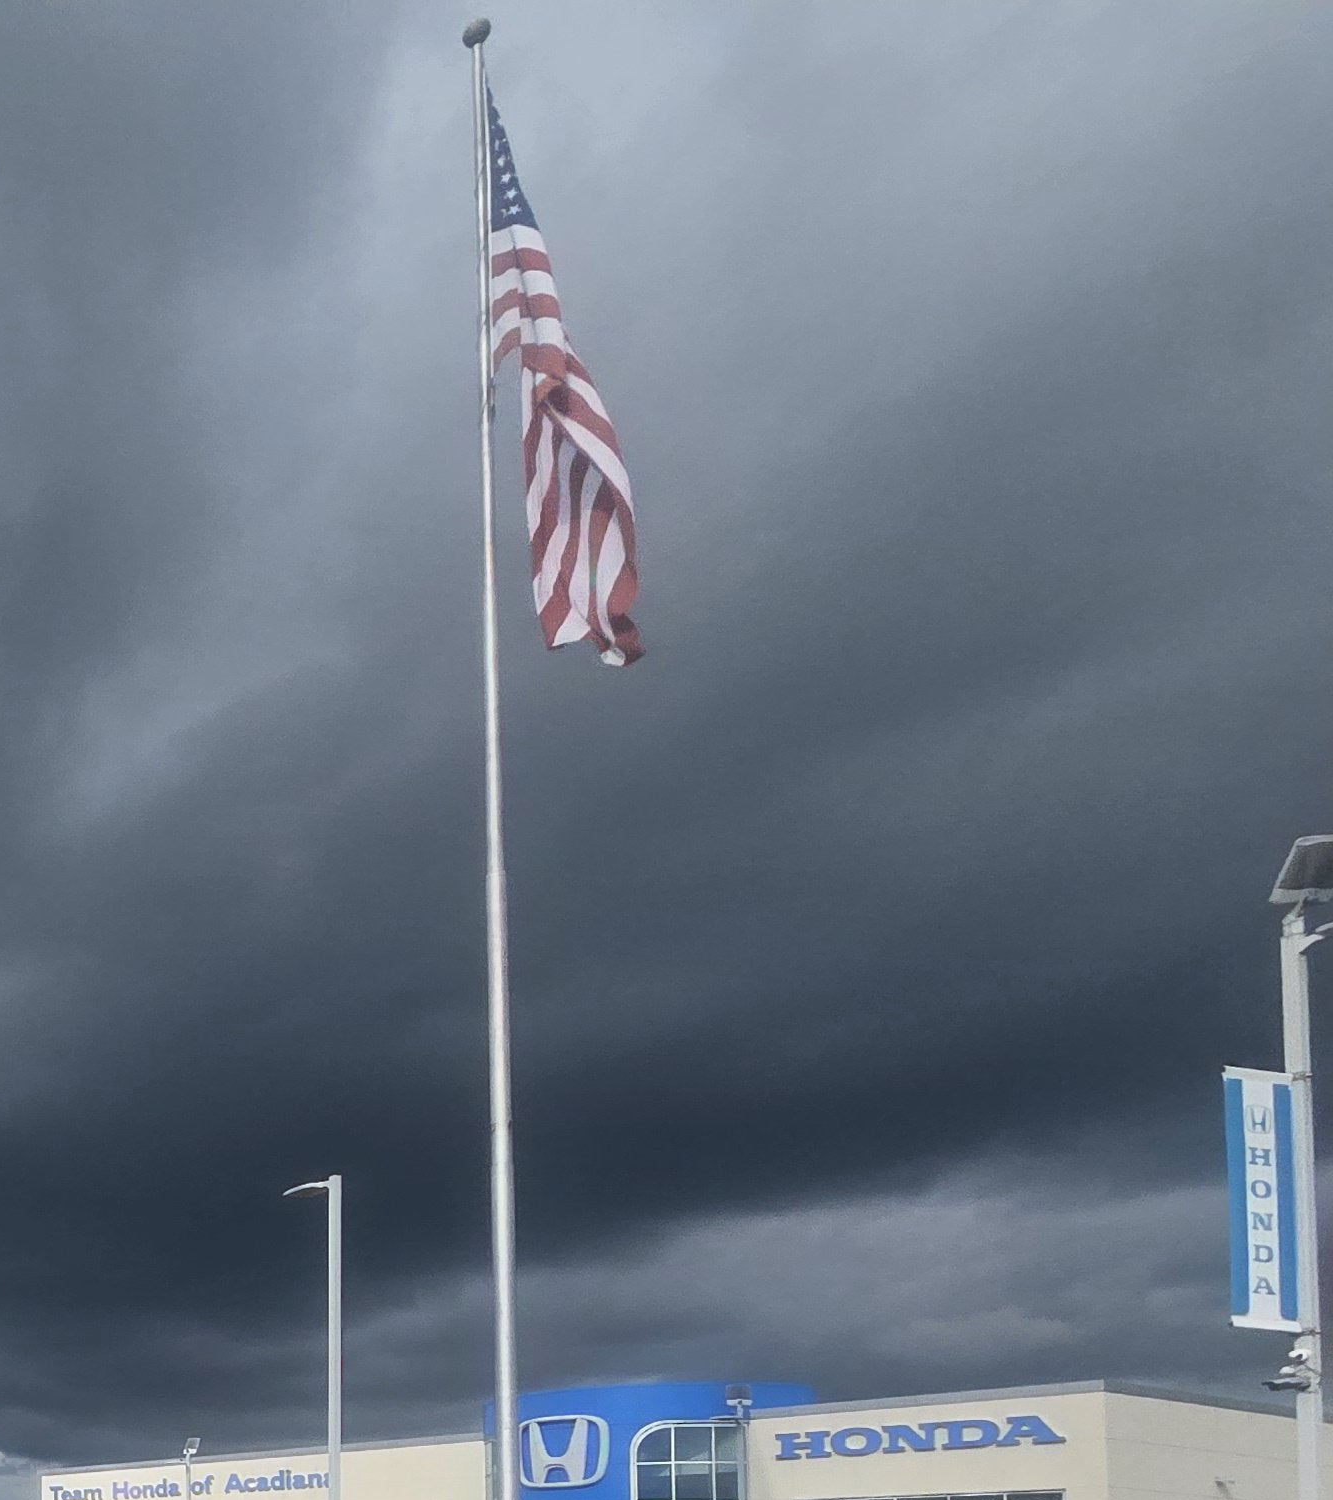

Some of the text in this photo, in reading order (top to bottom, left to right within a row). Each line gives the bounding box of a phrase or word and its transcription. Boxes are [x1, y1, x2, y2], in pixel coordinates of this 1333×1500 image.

[1247, 1146, 1276, 1295] HONDA
[775, 1415, 1067, 1461] HONDA
[112, 1478, 181, 1500] Honda
[189, 1475, 215, 1496] of
